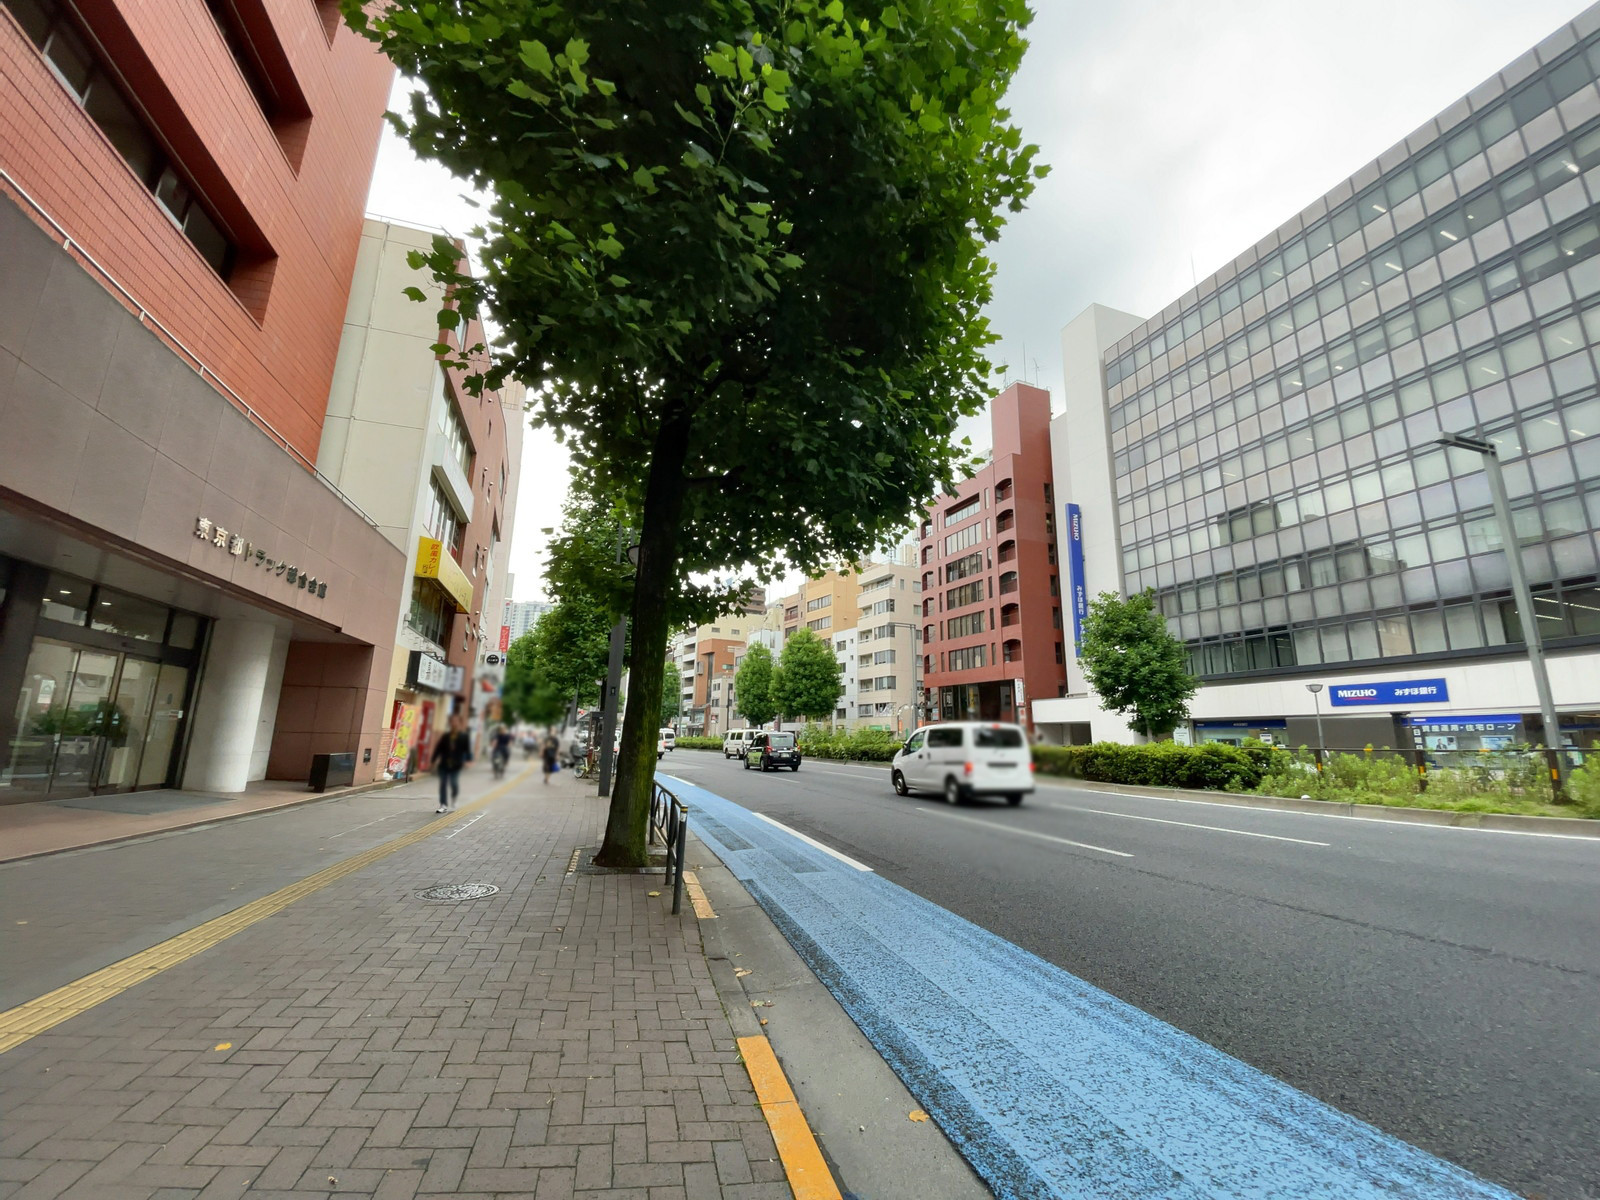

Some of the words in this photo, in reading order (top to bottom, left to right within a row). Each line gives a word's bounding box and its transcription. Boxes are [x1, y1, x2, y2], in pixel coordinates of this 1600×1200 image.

[1072, 513, 1080, 541] MIZUHO
[1337, 688, 1378, 698] MIZUHO
[1394, 686, 1437, 696] みずほ銀行
